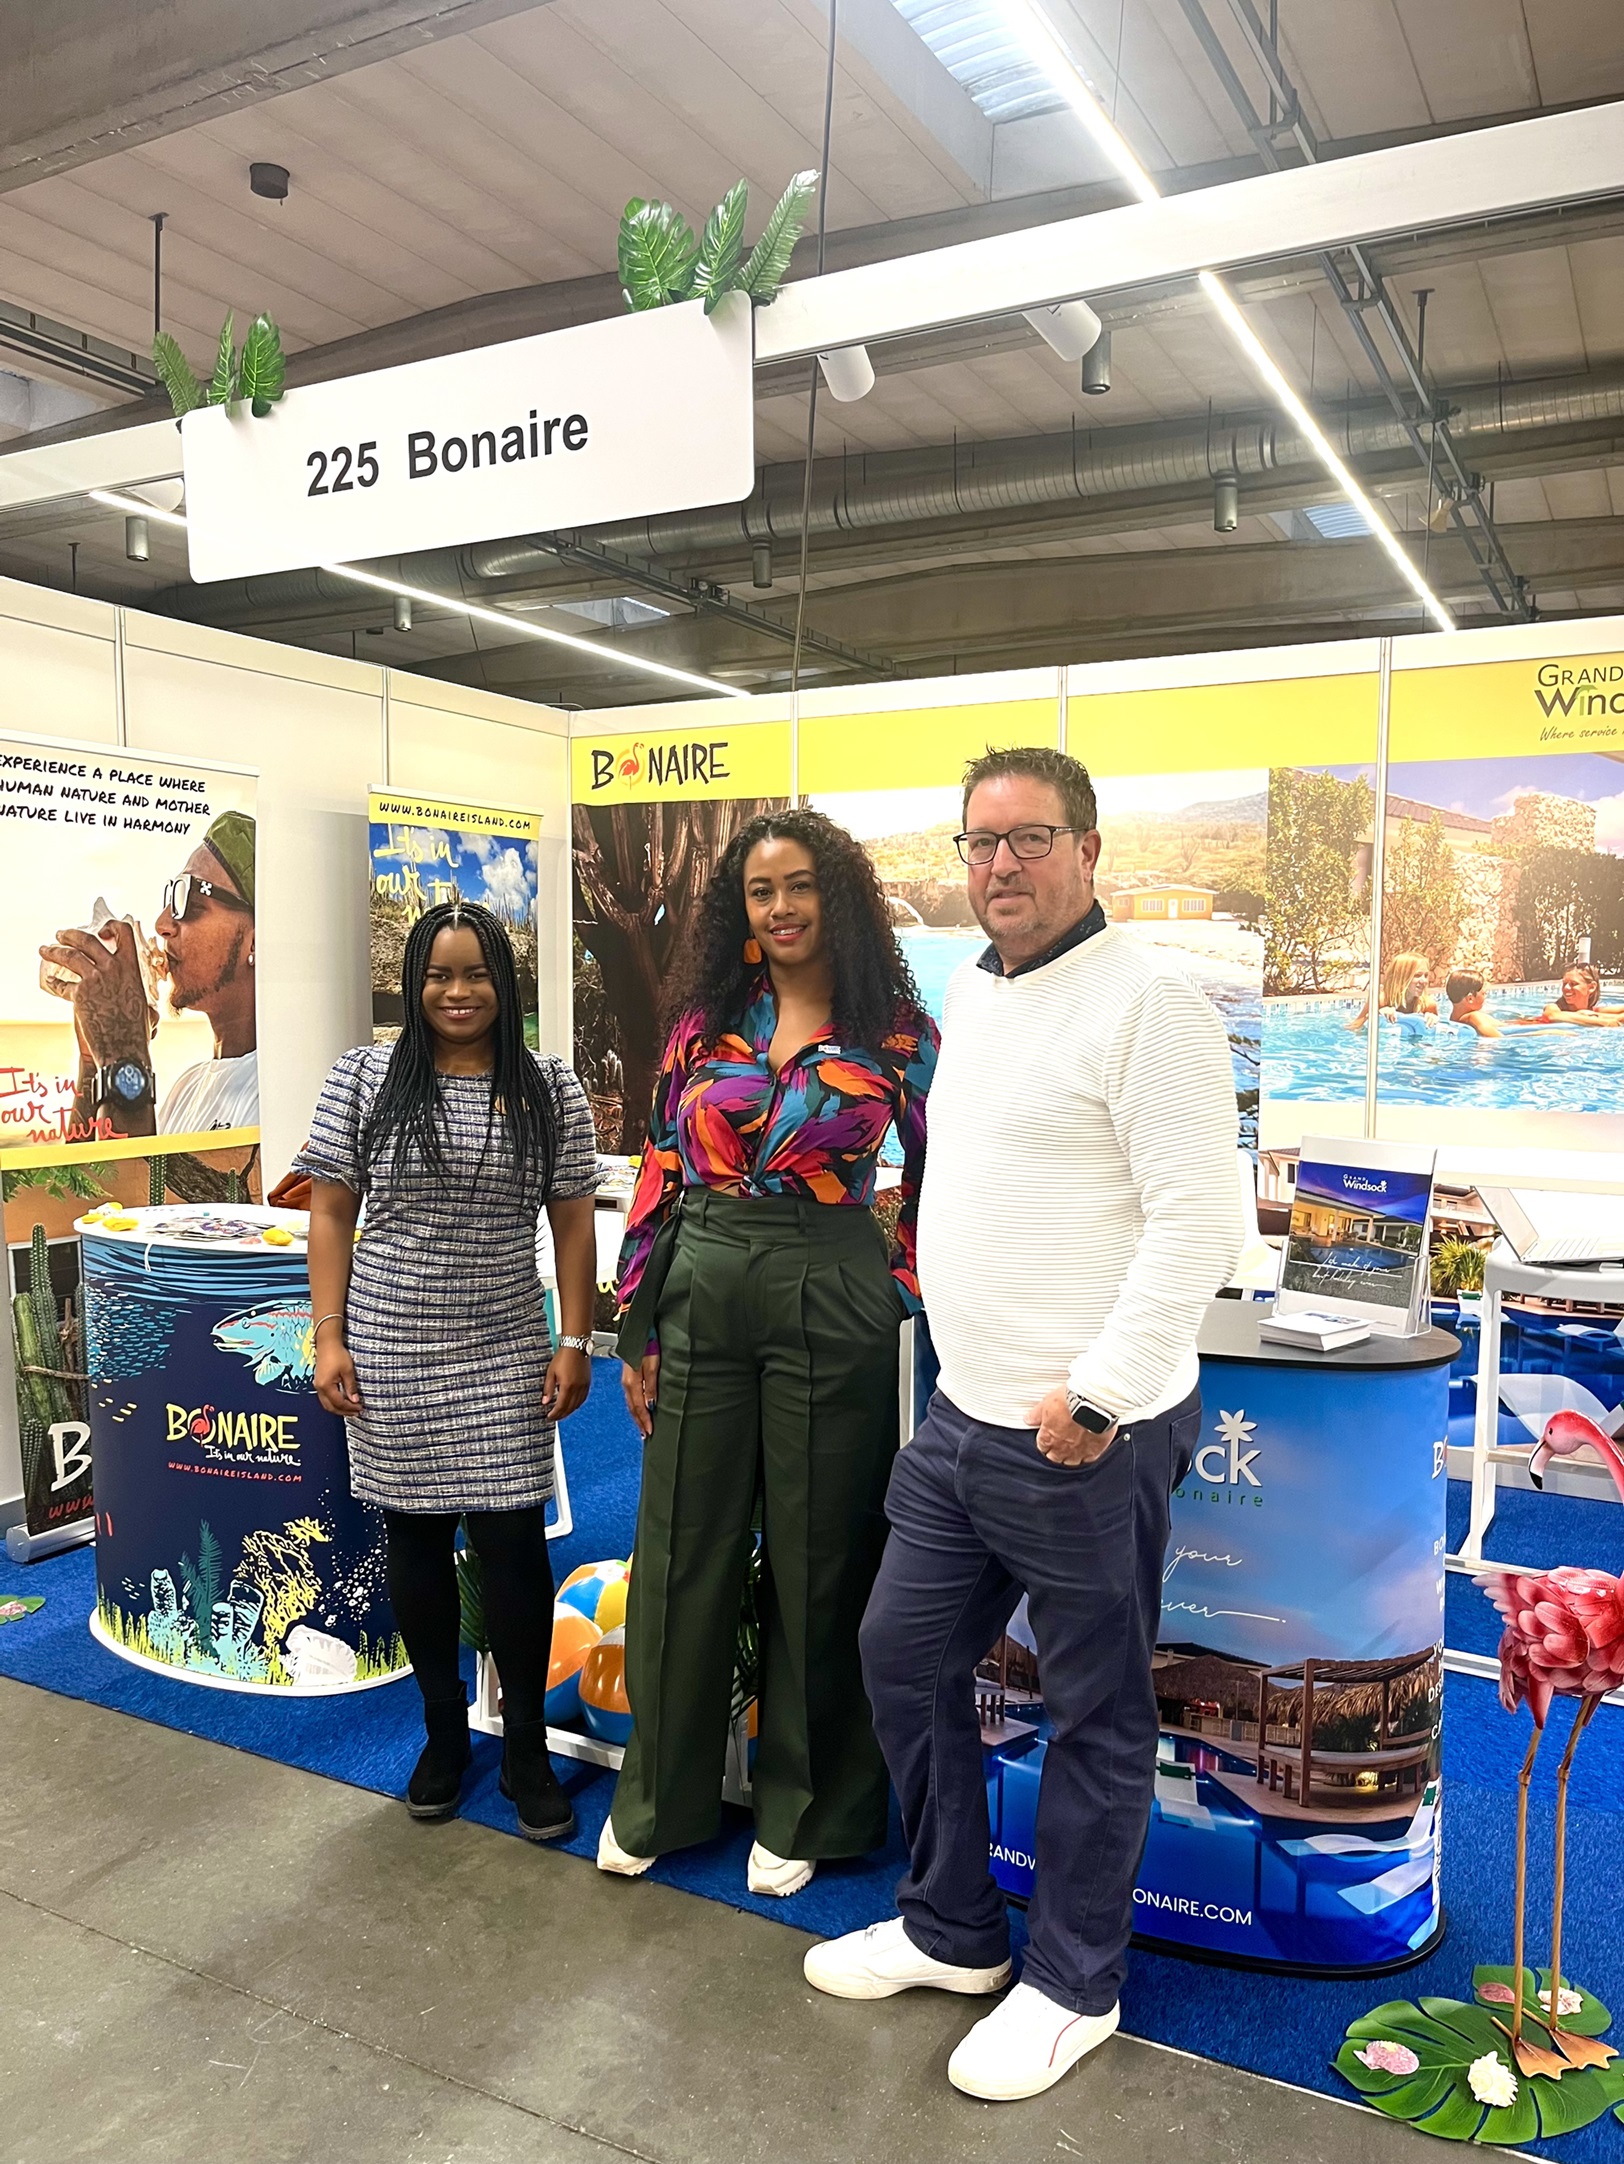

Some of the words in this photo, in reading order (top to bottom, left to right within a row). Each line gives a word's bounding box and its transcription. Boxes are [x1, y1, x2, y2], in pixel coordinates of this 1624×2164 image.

[306, 440, 380, 497] 225
[408, 409, 589, 480] Bonaire
[1538, 664, 1624, 687] GRAND
[1540, 726, 1575, 741] Where
[1579, 725, 1617, 738] service
[0, 753, 87, 777] XPERIENCE
[92, 767, 103, 779] A
[109, 769, 154, 786] PLACE
[159, 776, 206, 793] WHERE
[591, 742, 730, 790] BONAIRE
[61, 786, 117, 804] NATURE
[122, 794, 150, 808] AND
[155, 798, 211, 816] MOTHER
[379, 802, 531, 830] WWW.BONAIREISLAND.COM
[64, 810, 97, 826] LIVE
[103, 815, 118, 827] IN
[123, 817, 191, 835] HARMONY
[429, 835, 460, 869] in
[376, 864, 428, 901] our
[55, 1076, 84, 1097] in
[1, 1101, 52, 1124] our
[26, 1106, 129, 1143] nature
[1342, 1179, 1387, 1193] Windsock
[166, 1403, 301, 1453] BONAIRE
[168, 1461, 302, 1482] WWW.BONAIREISLAND.COM
[1176, 1488, 1263, 1507] onaire
[1162, 1545, 1242, 1582] your
[1132, 1888, 1252, 1926] ONAIRE.COM
